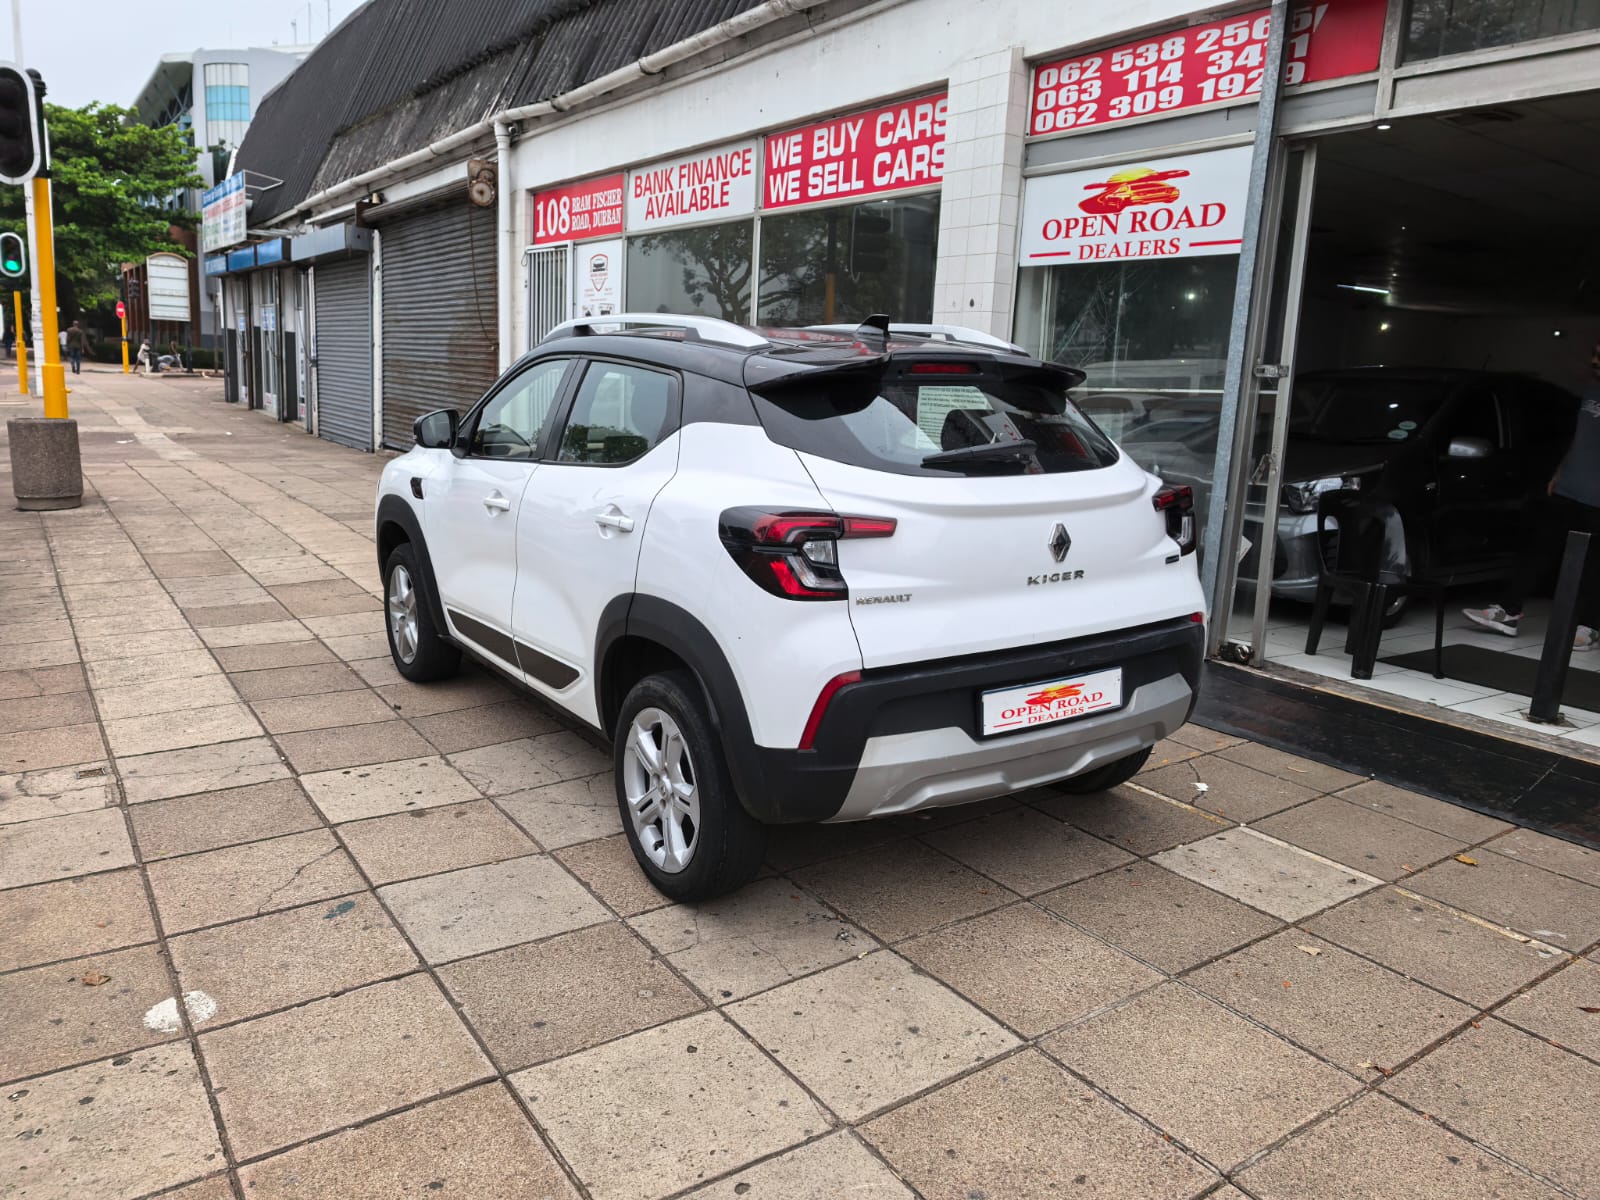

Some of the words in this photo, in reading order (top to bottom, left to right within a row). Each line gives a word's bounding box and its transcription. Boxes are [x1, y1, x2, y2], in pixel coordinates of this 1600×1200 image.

[1036, 79, 1102, 111] 063
[1122, 60, 1184, 93] 114
[1206, 33, 1310, 75] 341
[1038, 57, 1103, 89] 062
[1110, 36, 1186, 72] 538
[1034, 102, 1098, 132] 062
[1108, 85, 1184, 118] 309
[771, 133, 803, 169] WE
[812, 118, 864, 161] BUY
[875, 98, 948, 148] CARS
[634, 166, 674, 199] BANK
[678, 147, 753, 189] FINANCE
[769, 169, 802, 203] WE
[807, 158, 864, 197] SELL
[872, 140, 946, 187] CARS
[536, 195, 570, 238] 108
[571, 194, 591, 214] BRAM
[592, 188, 622, 209] FISCHER
[571, 212, 592, 232] ROAD,
[592, 207, 622, 228] DURBAN
[645, 180, 730, 221] AVAILABLE
[1042, 212, 1122, 241] OPEN
[1128, 202, 1226, 234] ROAD
[1078, 237, 1181, 260] DEALERS
[1027, 569, 1085, 586] KIGER
[855, 592, 913, 605] RENAULT
[1001, 702, 1051, 719] OPEN
[1057, 691, 1104, 710] ROAD
[1027, 706, 1085, 724] DEALERS
